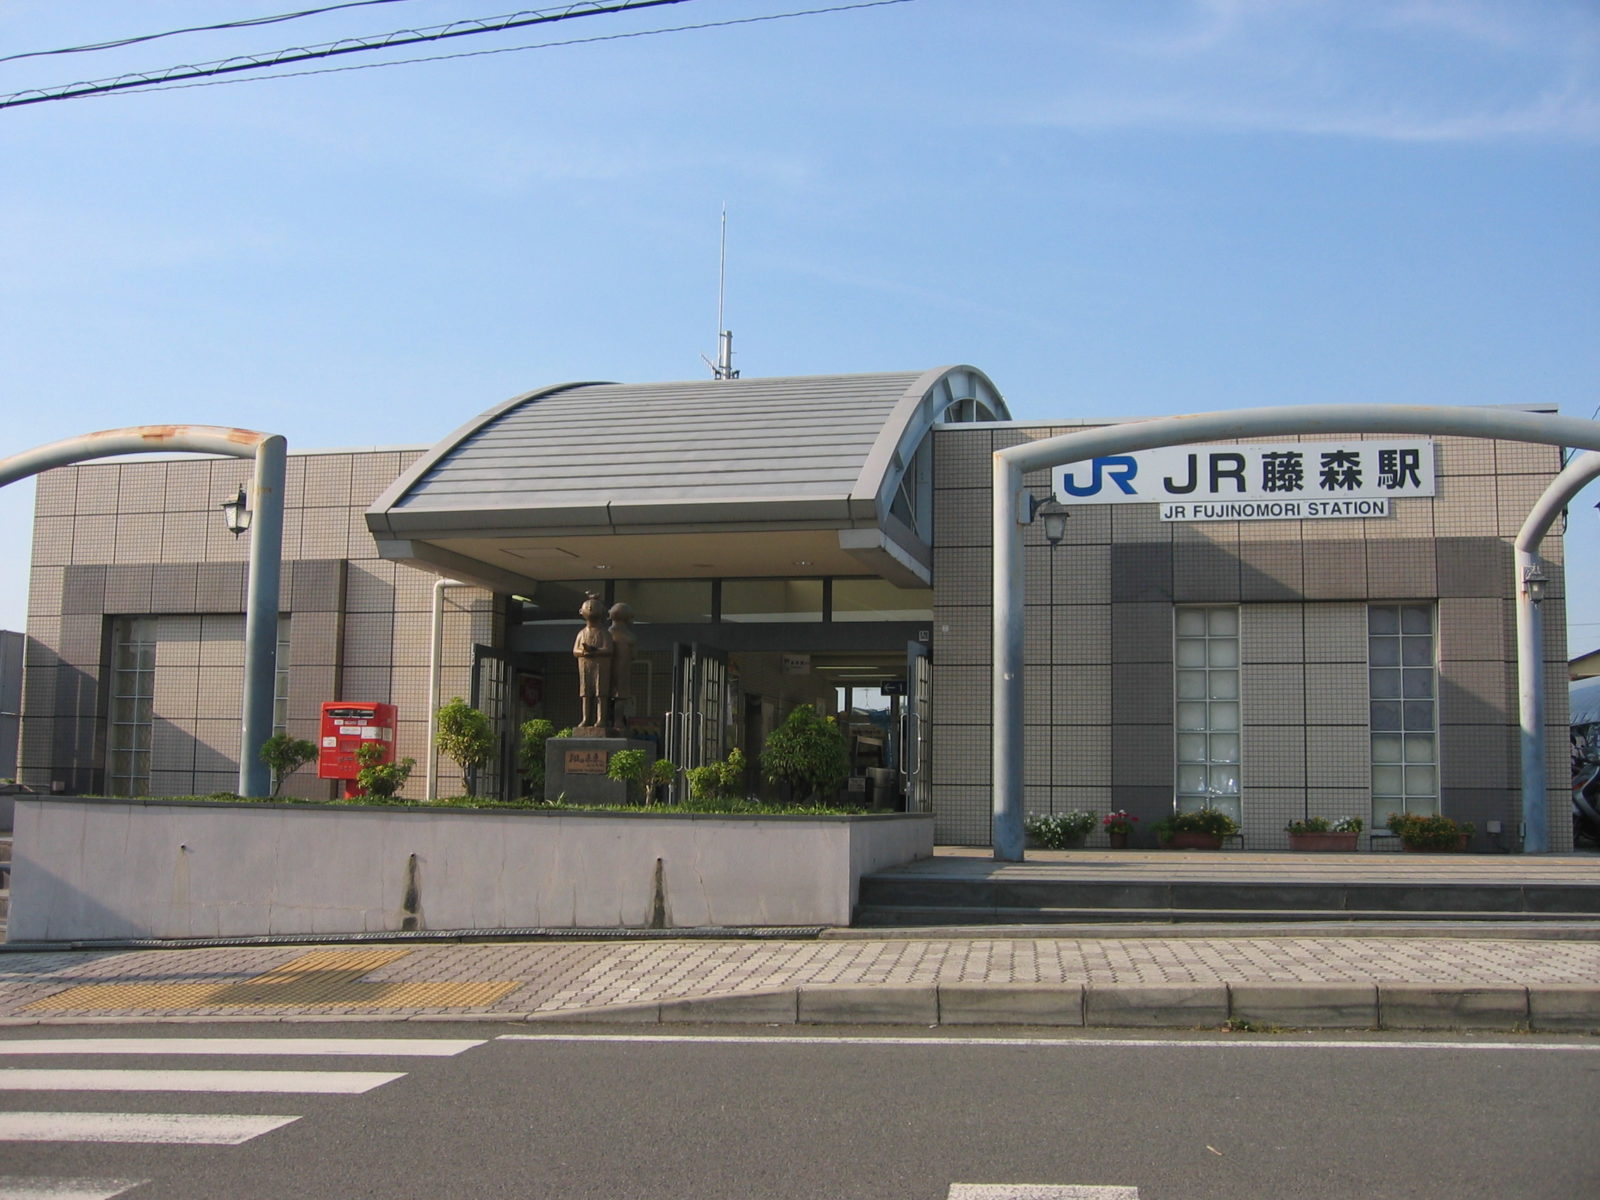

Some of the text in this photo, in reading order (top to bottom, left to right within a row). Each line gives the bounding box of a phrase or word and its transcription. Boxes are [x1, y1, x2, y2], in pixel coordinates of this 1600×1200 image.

[1064, 456, 1138, 497] JR
[1164, 501, 1384, 519] JR FUJINOMORI STATION
